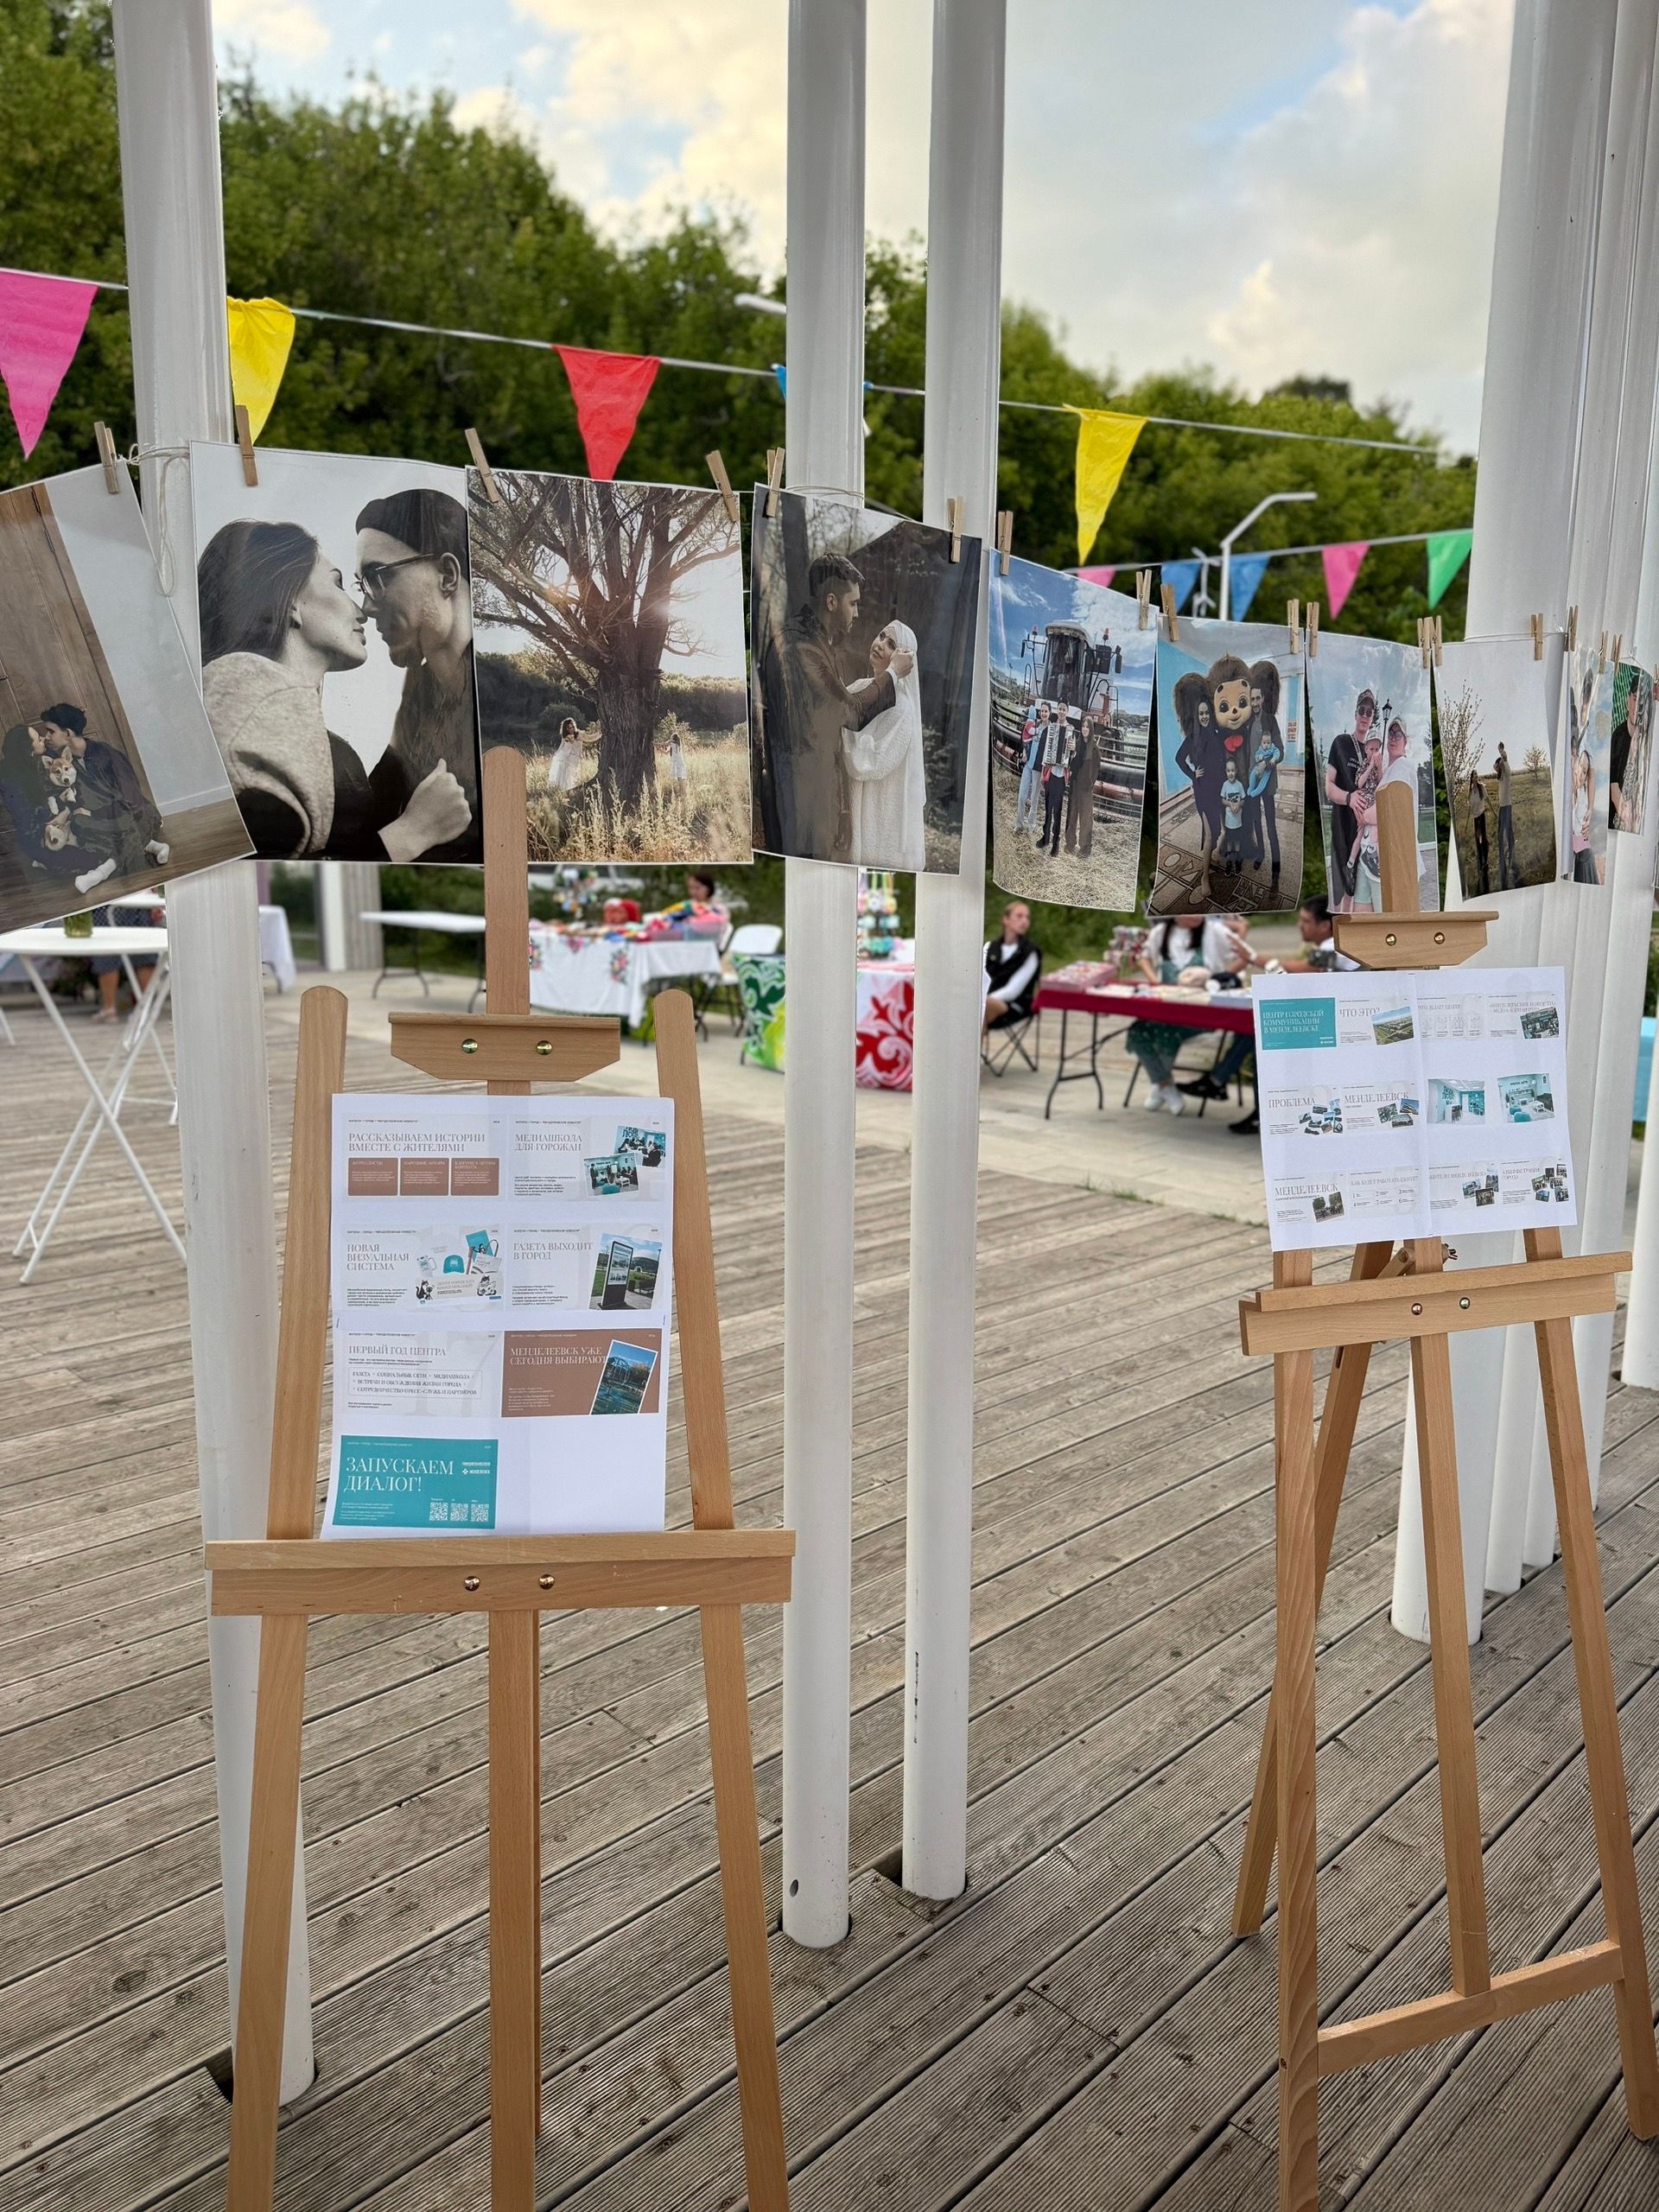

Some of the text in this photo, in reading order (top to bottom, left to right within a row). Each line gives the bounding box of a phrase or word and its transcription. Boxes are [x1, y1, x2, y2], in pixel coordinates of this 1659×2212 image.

[1339, 1008, 1357, 1018] ЧТО
[1344, 1091, 1409, 1104] МЕНДЕЛЕЕВСК
[1268, 1097, 1315, 1109] ПРОБЛЕМА
[348, 1133, 485, 1142] РАССКАЗЫВАЕМ ИСТОРИИ
[515, 1134, 582, 1142] МЕДИАШКОЛА
[348, 1143, 464, 1152] ВМЕСТЕ С ЖИТЕЛЯМИ
[514, 1143, 582, 1152] ДЛЯ ГОРОЖАН
[1274, 1183, 1338, 1196] МЕНДЕЛЕЕВСК
[513, 1242, 594, 1251] ГАЗЕТА ВЫХОДИТ
[347, 1253, 409, 1262] ВИЗУАЛЬНАЯ
[521, 1251, 551, 1260] ГОРОД
[346, 1262, 395, 1271] СИСТЕМА
[348, 1344, 446, 1356] ПЕРВЫЙ ГОД ЦЕНТРА
[511, 1347, 602, 1356] МЕНДЕЛЕЕВСК УЖЕ
[510, 1356, 607, 1365] СЕГОДНЯ ВЫБИРАЮТ
[346, 1457, 454, 1475] ЗАПУСКАЕМ
[343, 1475, 422, 1492] ДИАЛОГ!
